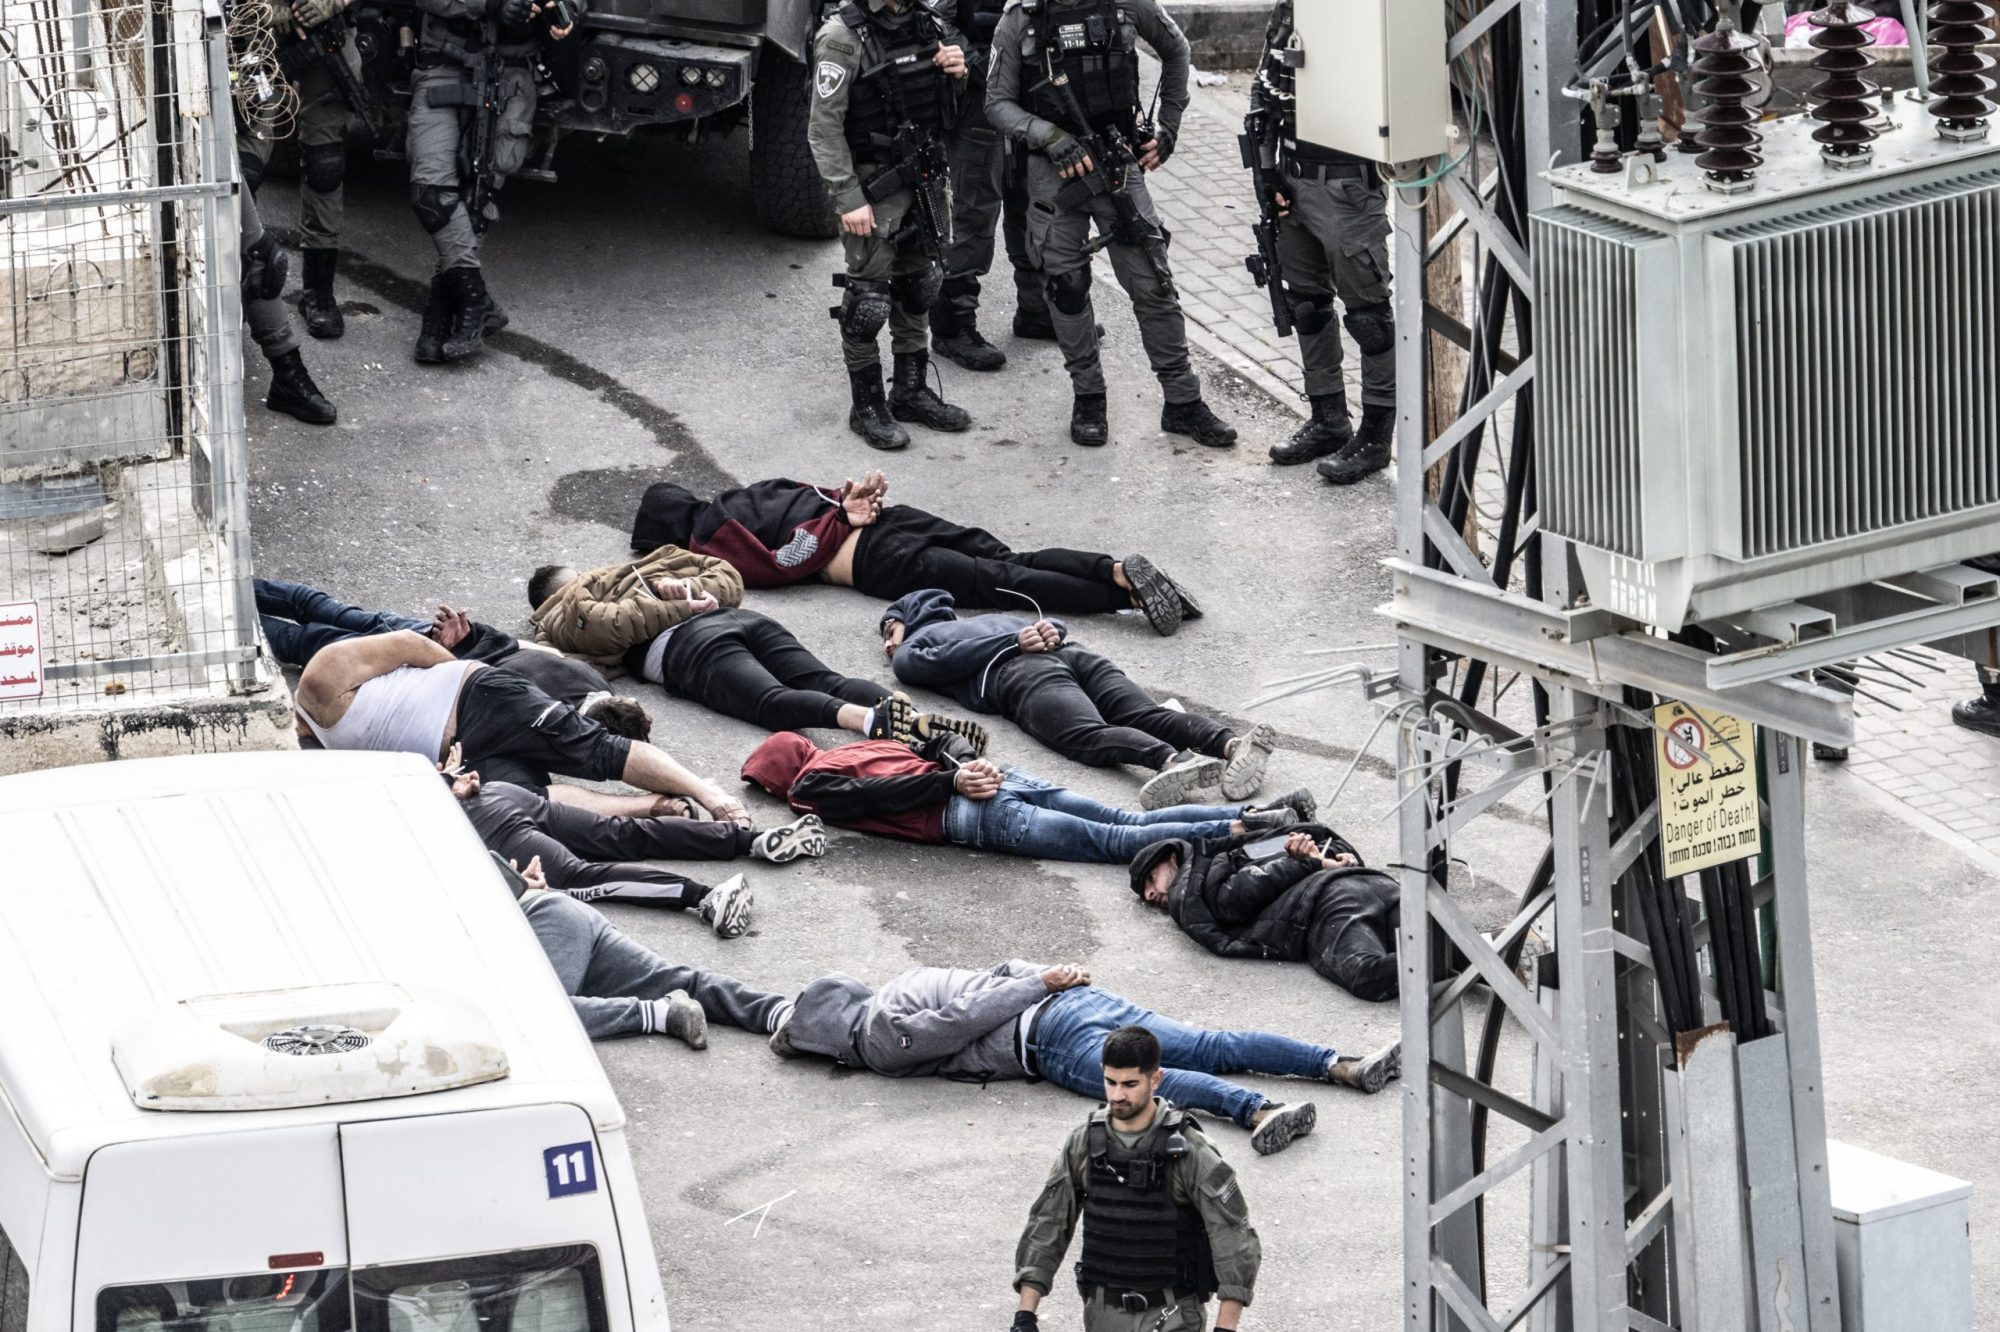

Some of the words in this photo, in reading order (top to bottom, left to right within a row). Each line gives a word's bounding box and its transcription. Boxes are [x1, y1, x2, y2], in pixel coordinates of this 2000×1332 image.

[1710, 760, 1745, 780] ضغط
[1719, 781, 1746, 806] خطر
[1666, 819, 1704, 843] Danger
[1706, 810, 1717, 832] of
[1720, 800, 1755, 829] Death!
[1739, 828, 1756, 846] מתח
[1692, 841, 1711, 858] סכנת
[570, 888, 601, 901] NIKE
[552, 1150, 587, 1185] 11
